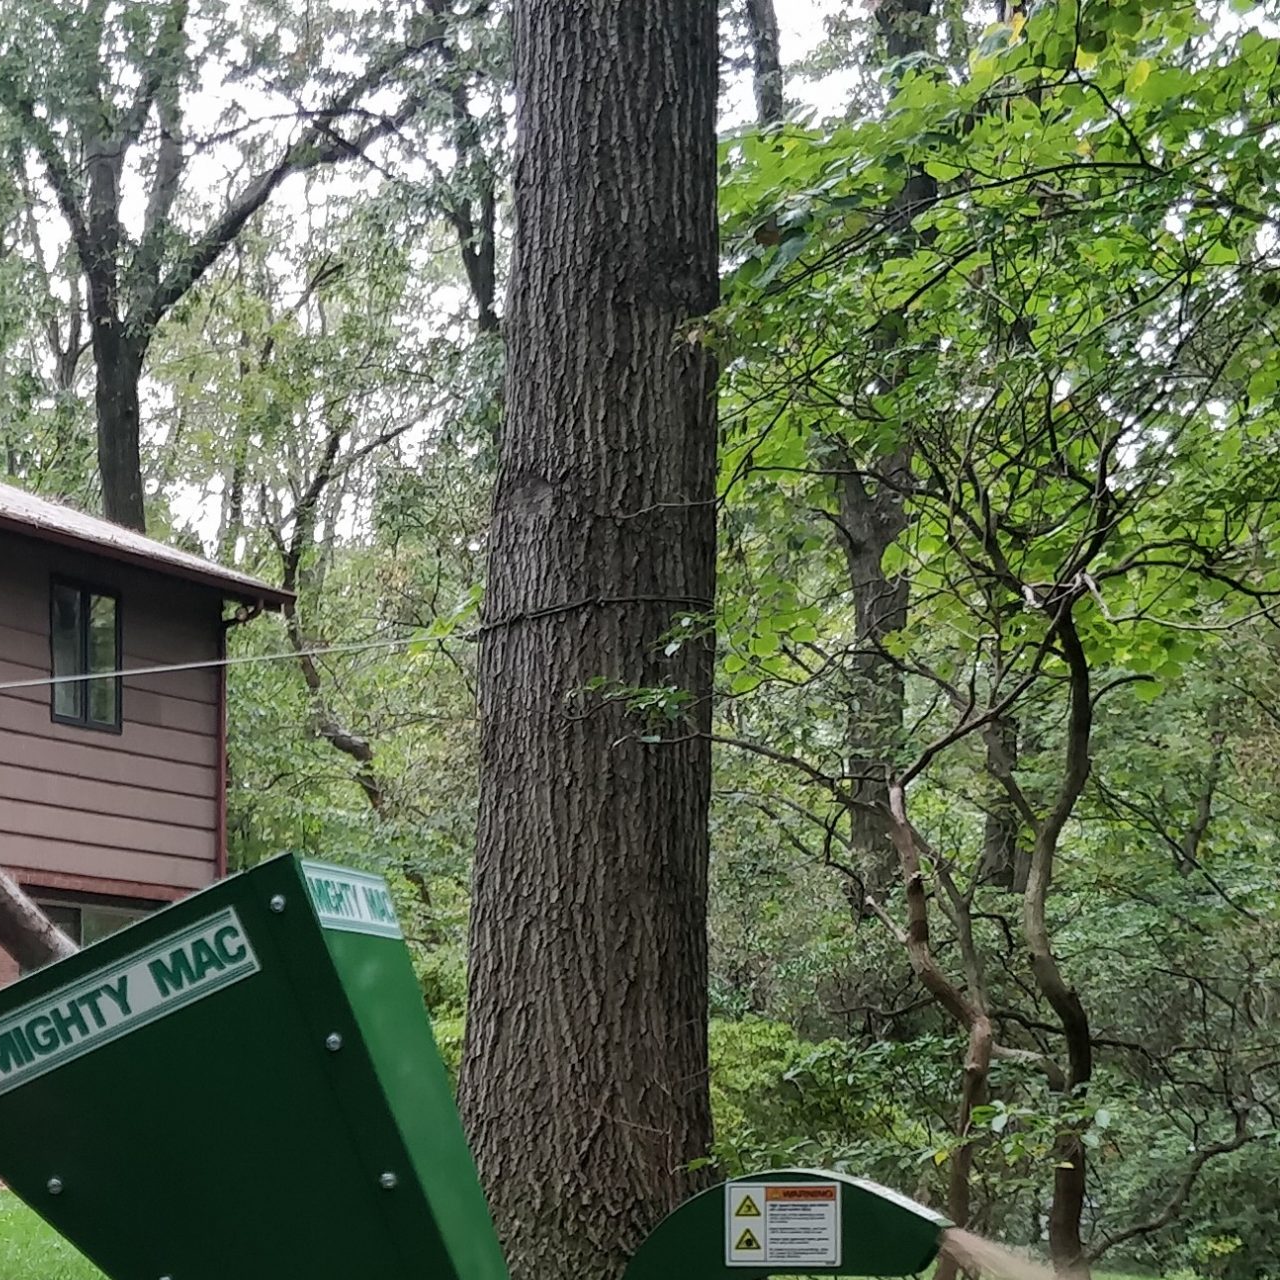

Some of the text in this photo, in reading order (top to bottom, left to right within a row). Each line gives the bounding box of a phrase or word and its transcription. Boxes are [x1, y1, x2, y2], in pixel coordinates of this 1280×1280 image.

[307, 877, 397, 923] MIGHTY MAC
[147, 925, 247, 998] MAC
[782, 1189, 834, 1198] WARNING
